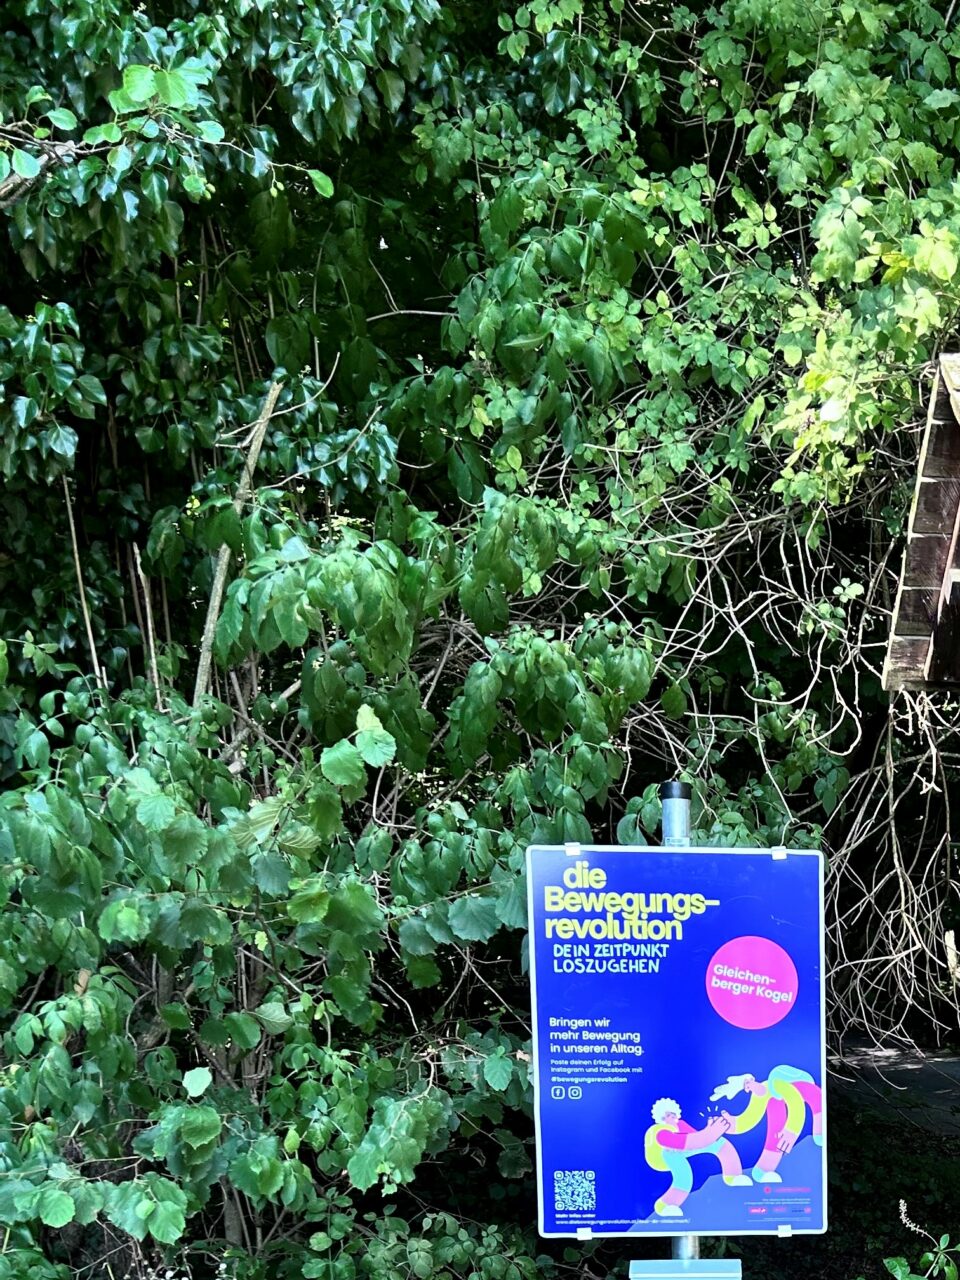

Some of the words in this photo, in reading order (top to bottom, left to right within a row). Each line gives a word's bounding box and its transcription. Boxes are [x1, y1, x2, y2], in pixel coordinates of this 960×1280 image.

[563, 861, 607, 889] die
[544, 886, 720, 921] Bewegungs-
[545, 912, 683, 940] revolution
[553, 943, 590, 958] DEIN
[593, 943, 670, 958] ZEITPUNKT
[553, 958, 660, 973] LOSZUGEHEN
[713, 964, 777, 985] Gleichen-
[711, 975, 755, 995] berger
[756, 985, 793, 1003] Kogel
[549, 1017, 592, 1029] Bringen
[594, 1017, 611, 1027] wir
[550, 1030, 580, 1040] mehr
[582, 1030, 641, 1043] Bewegung
[550, 1043, 561, 1053] in
[563, 1045, 608, 1053] unseren
[593, 1059, 612, 1067] Erfolg
